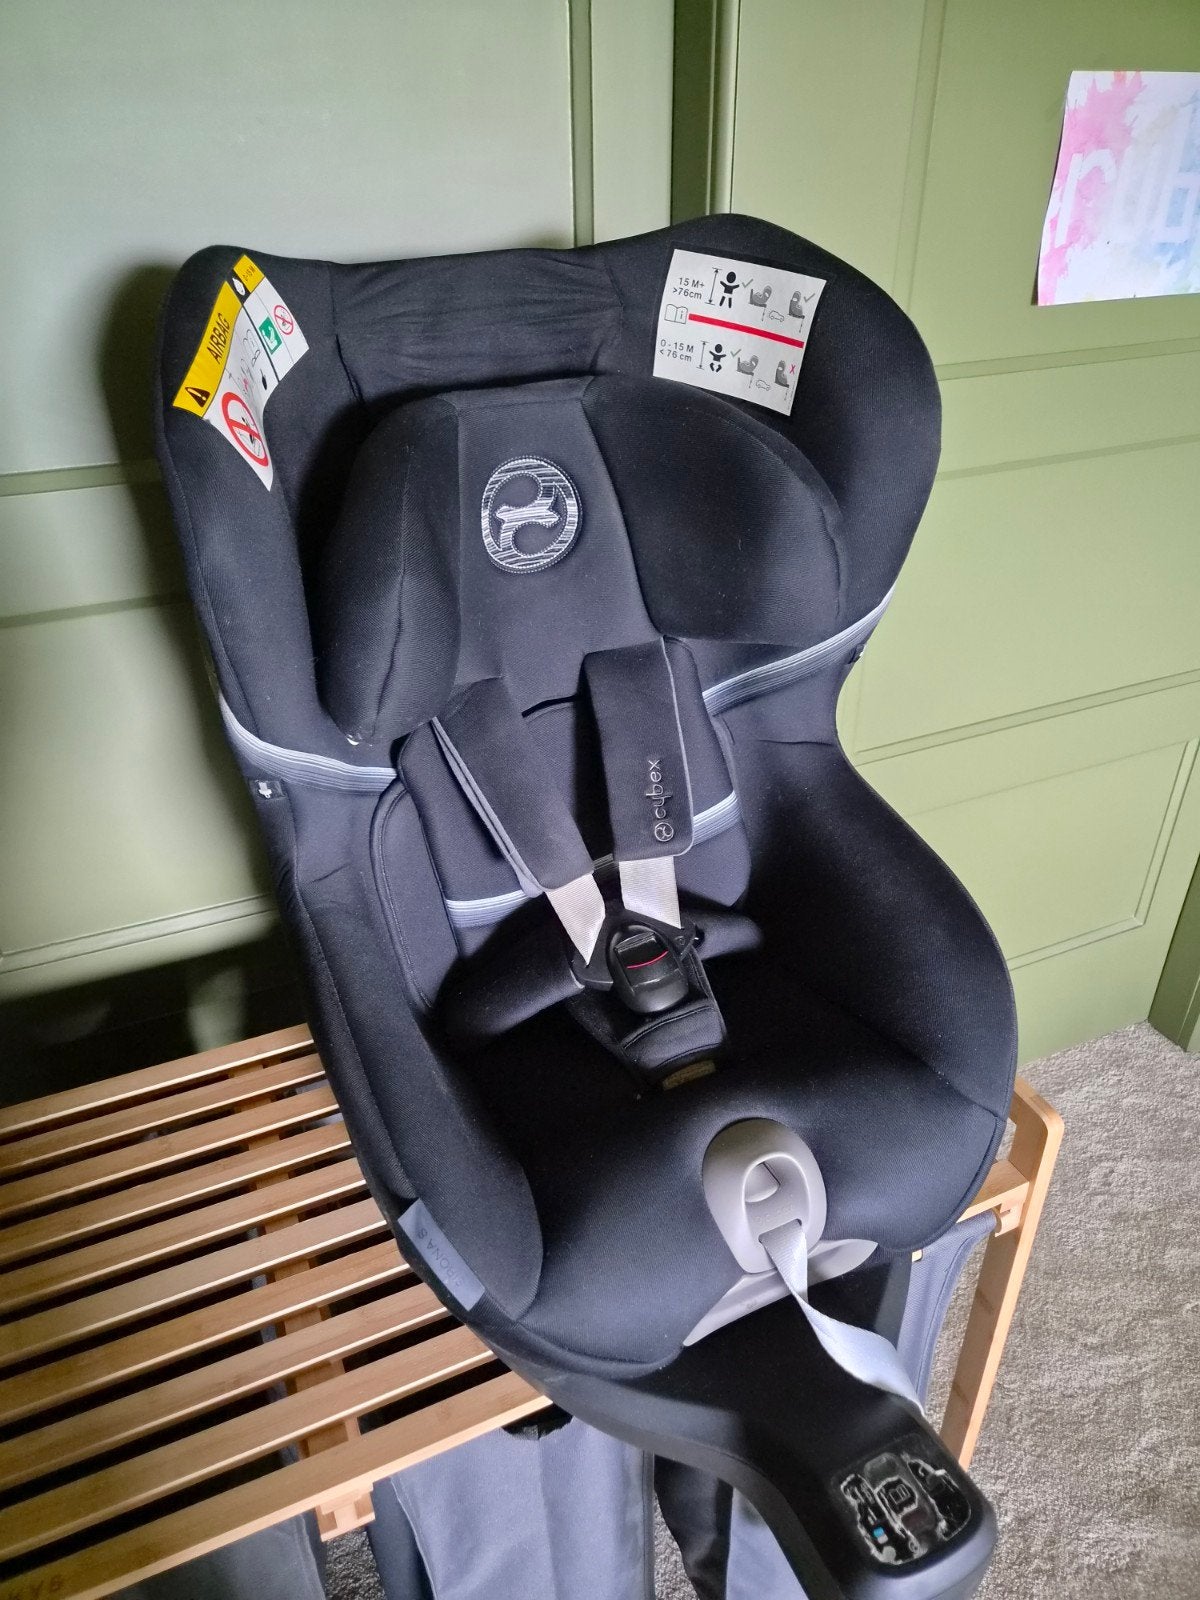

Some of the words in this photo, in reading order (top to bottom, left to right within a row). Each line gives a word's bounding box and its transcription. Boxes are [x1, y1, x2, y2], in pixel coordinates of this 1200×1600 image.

[679, 277, 690, 287] 15
[691, 279, 705, 289] M+
[206, 312, 230, 365] AIRBAG
[674, 342, 685, 352] 15
[686, 345, 694, 354] M
[667, 350, 678, 359] 76
[680, 353, 692, 362] cm
[645, 759, 672, 819] cybex
